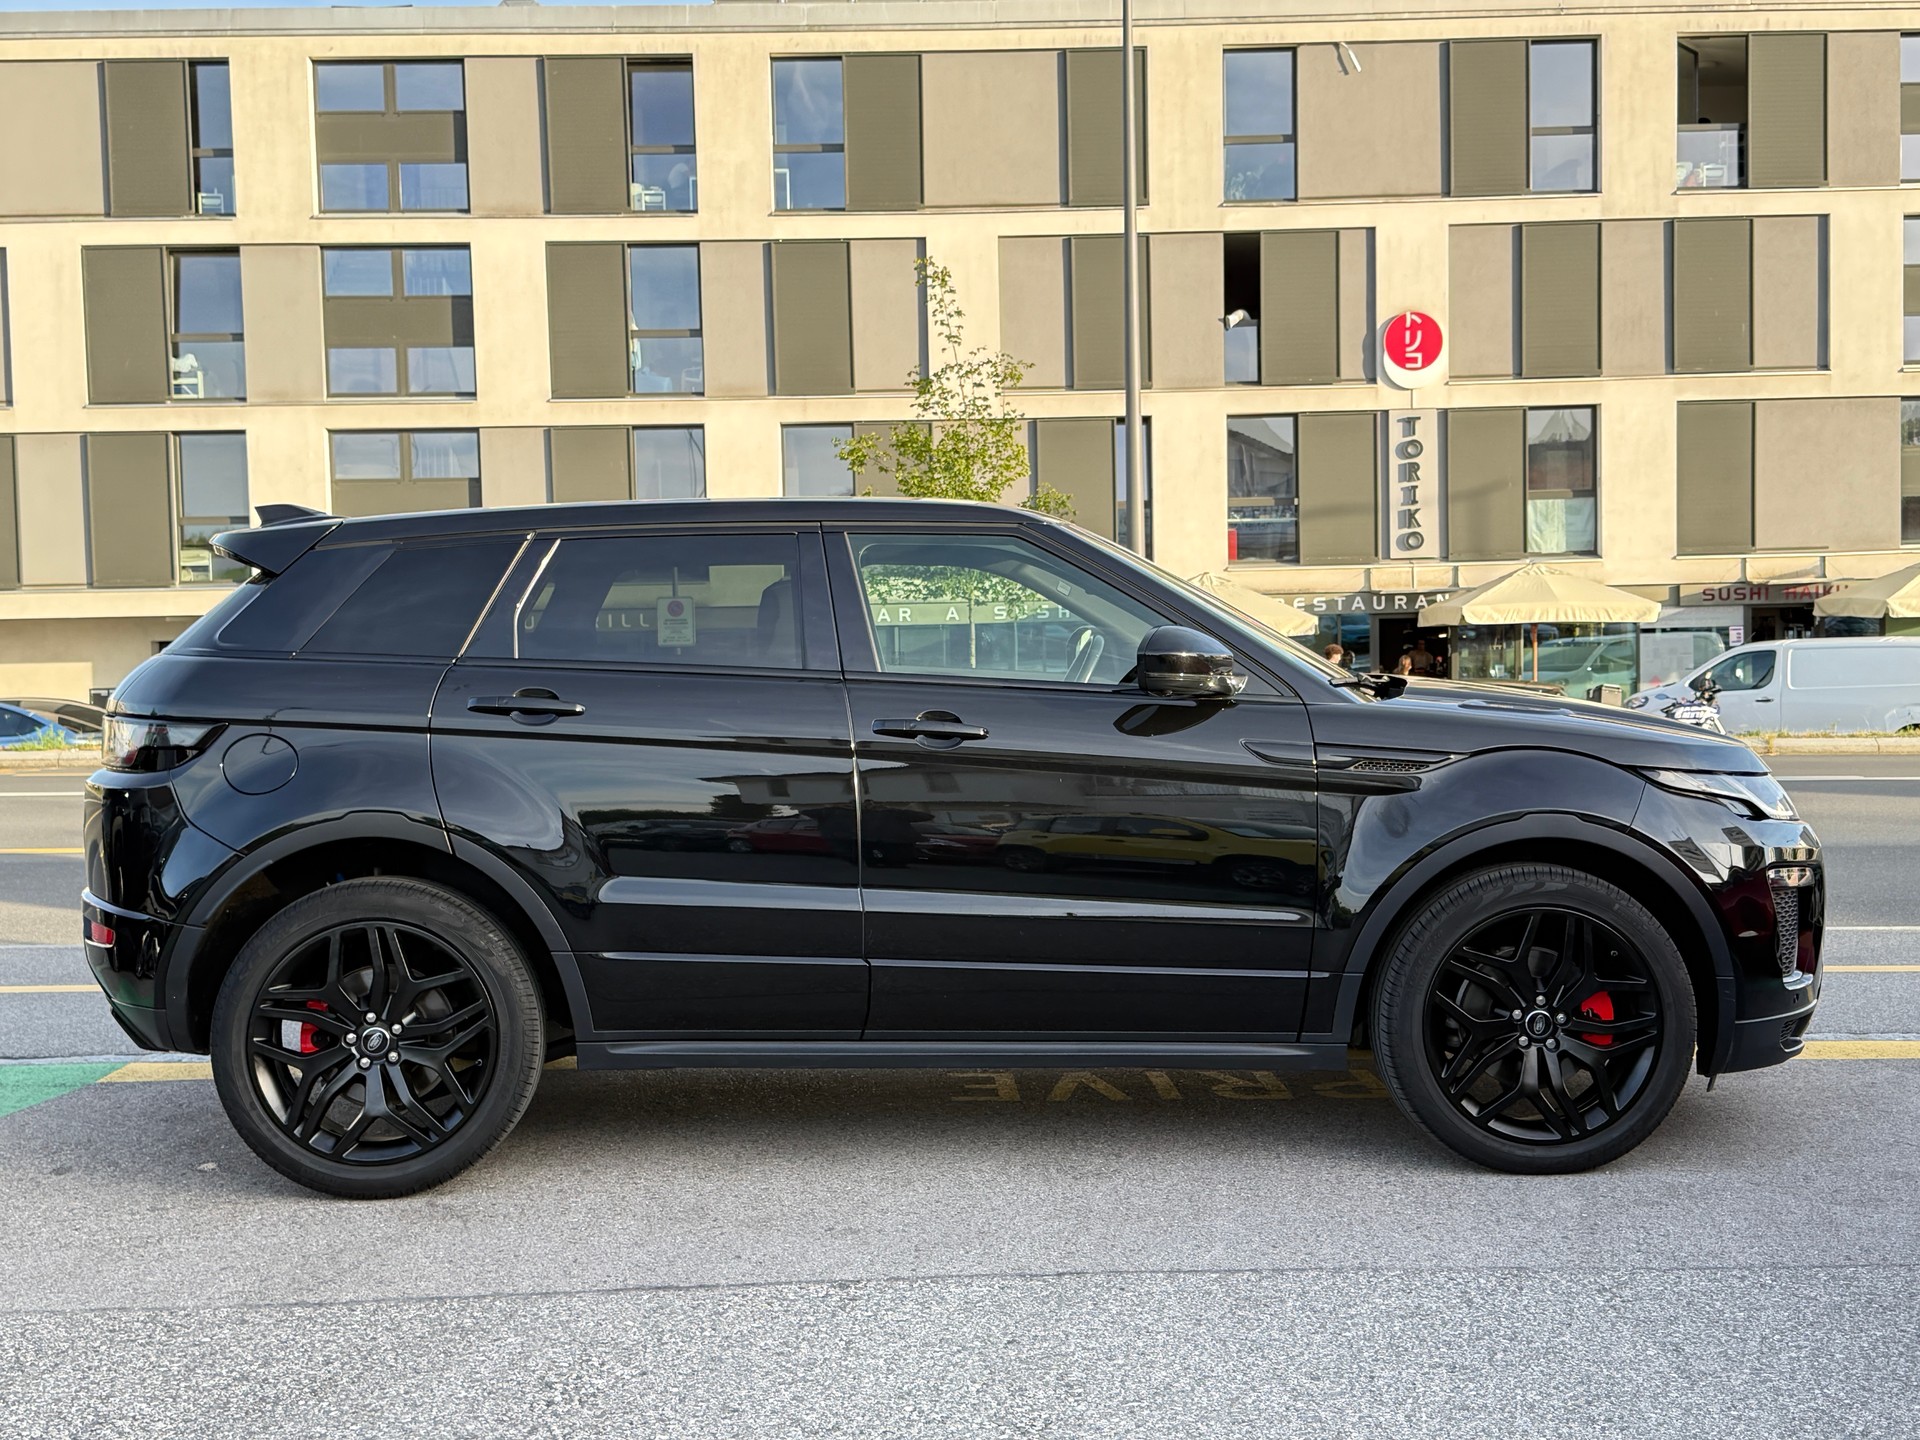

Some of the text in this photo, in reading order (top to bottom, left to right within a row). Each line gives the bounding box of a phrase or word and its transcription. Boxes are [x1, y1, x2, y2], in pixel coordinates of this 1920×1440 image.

[1405, 311, 1422, 368] トリコ
[1396, 416, 1424, 551] TORIKO
[1702, 587, 1769, 602] SUSHI
[945, 606, 960, 621] A
